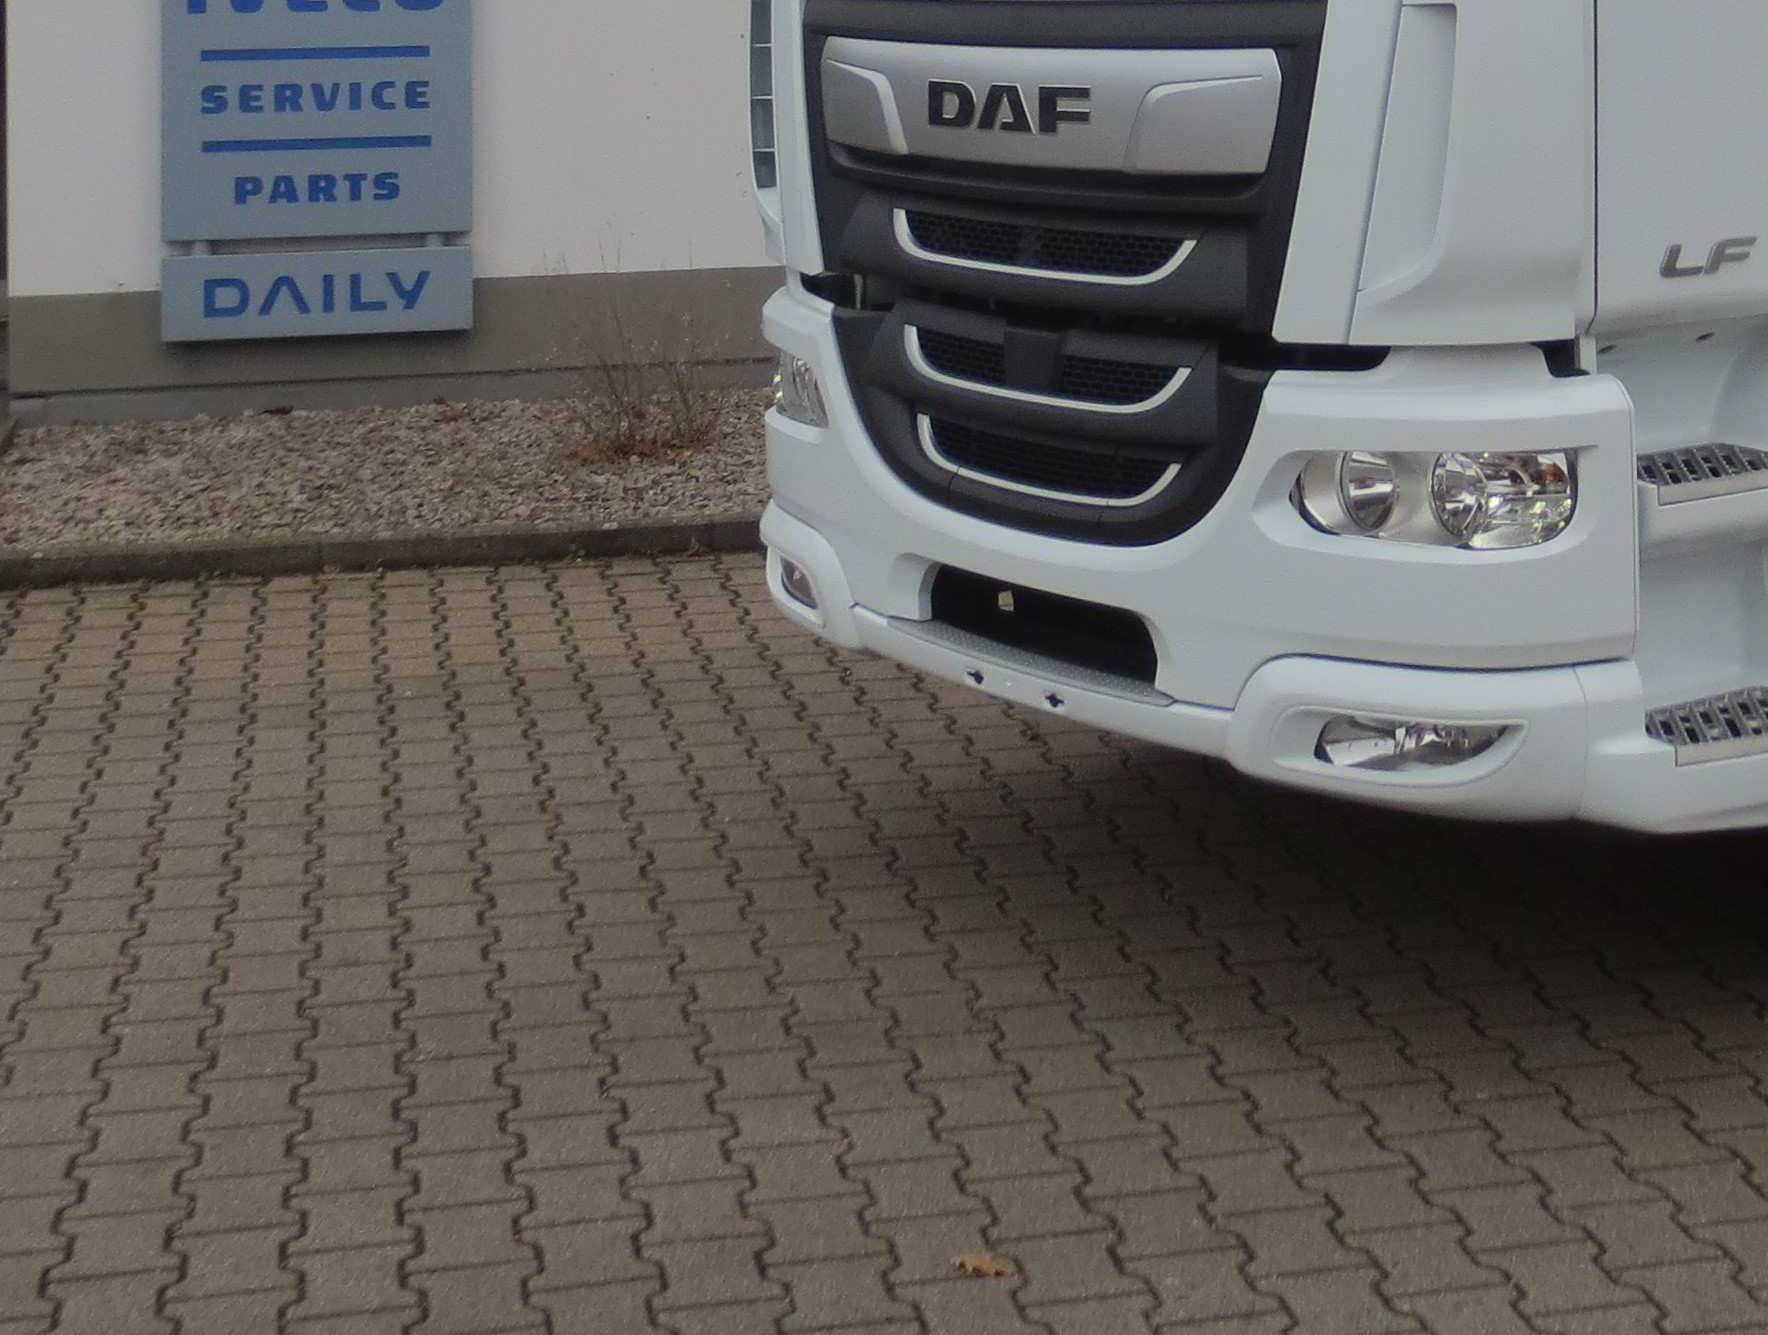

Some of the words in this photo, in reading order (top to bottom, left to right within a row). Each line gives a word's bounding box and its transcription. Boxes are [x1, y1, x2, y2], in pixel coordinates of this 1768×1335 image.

[200, 80, 431, 115] SERVICE
[928, 79, 1091, 133] DAF
[233, 172, 401, 206] PARTS
[1660, 236, 1757, 278] LF
[202, 270, 431, 319] DAILY
